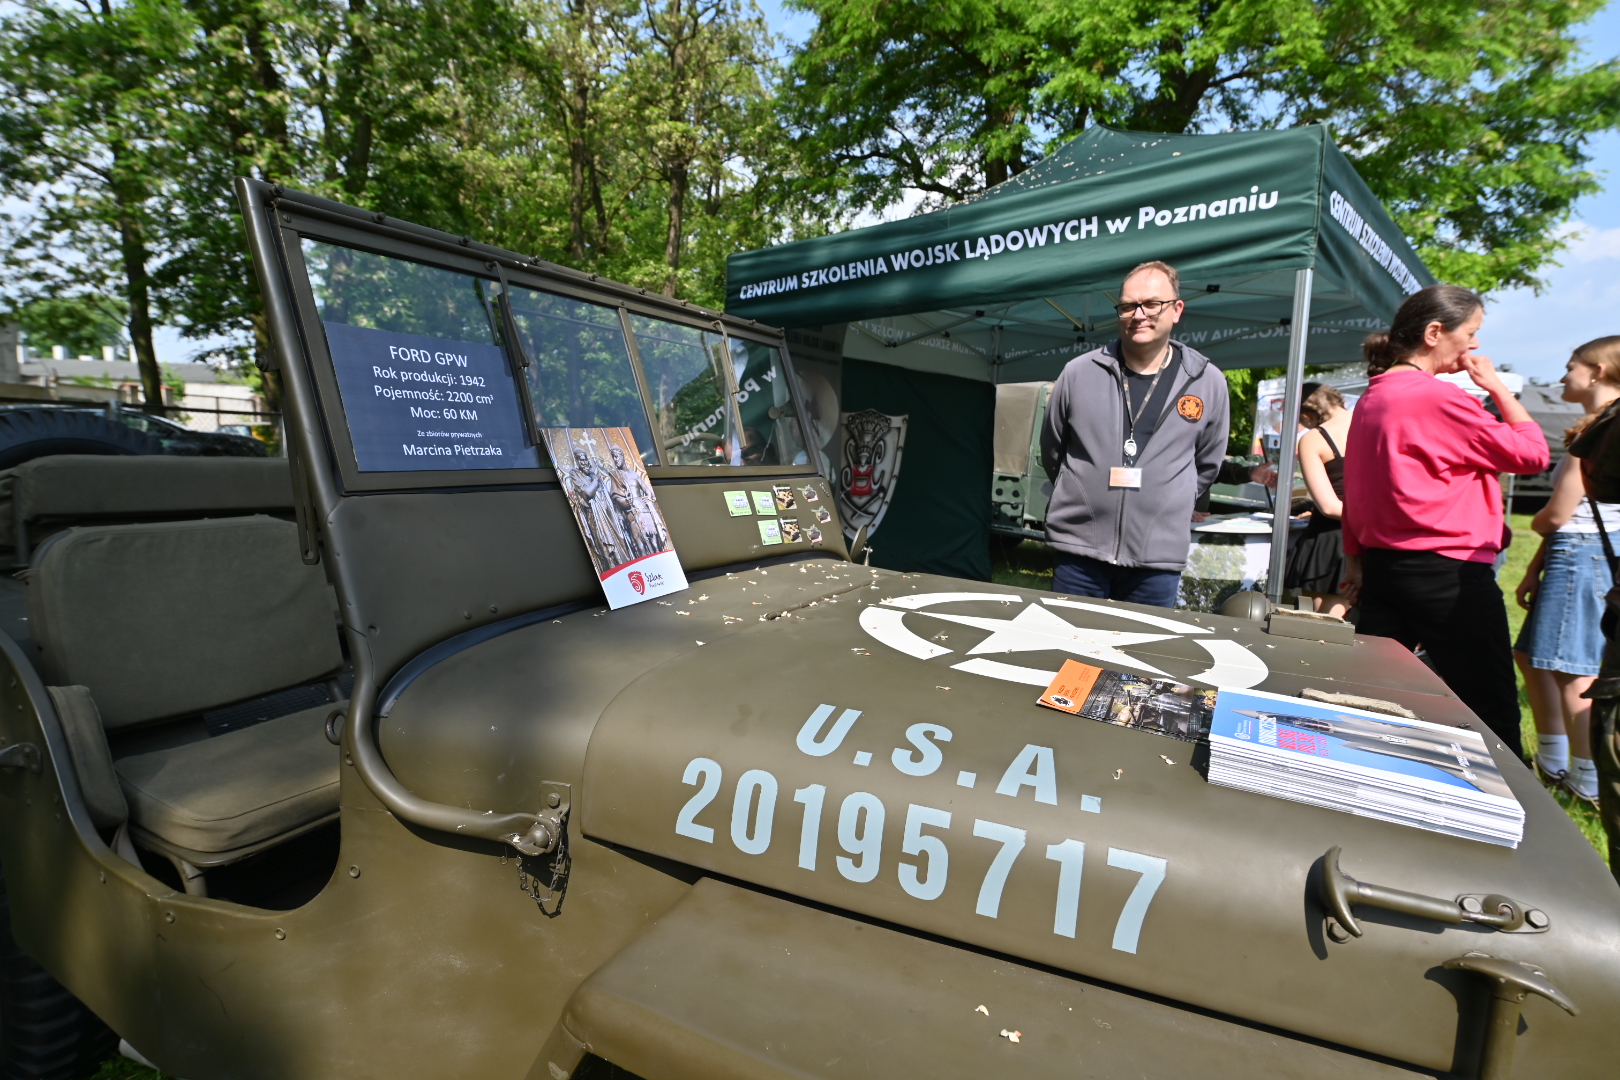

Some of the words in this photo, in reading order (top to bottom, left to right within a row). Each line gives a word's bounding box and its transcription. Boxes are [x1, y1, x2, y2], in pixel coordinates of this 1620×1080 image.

[1329, 190, 1364, 242] CENTRUM
[739, 275, 799, 299] CENTRUM
[801, 257, 888, 288] SZKOLENIA
[890, 242, 961, 271] WOJSK
[964, 216, 1098, 261] LĄDOWYCH
[1105, 216, 1132, 235] w
[1138, 185, 1279, 230] Poznaniu
[389, 346, 431, 364] FORD
[434, 352, 468, 368] GPW
[372, 366, 398, 380] Rok
[400, 370, 457, 387] produkcji:
[460, 375, 486, 388] 1942
[374, 385, 445, 401] Pojemność:
[446, 391, 474, 403] 2200
[410, 407, 441, 419] Moc:
[443, 408, 457, 420] 60
[459, 409, 478, 421] KM
[403, 444, 453, 456] Marcina
[453, 444, 503, 456] Pietrzaka
[675, 757, 1168, 955] 20195717
